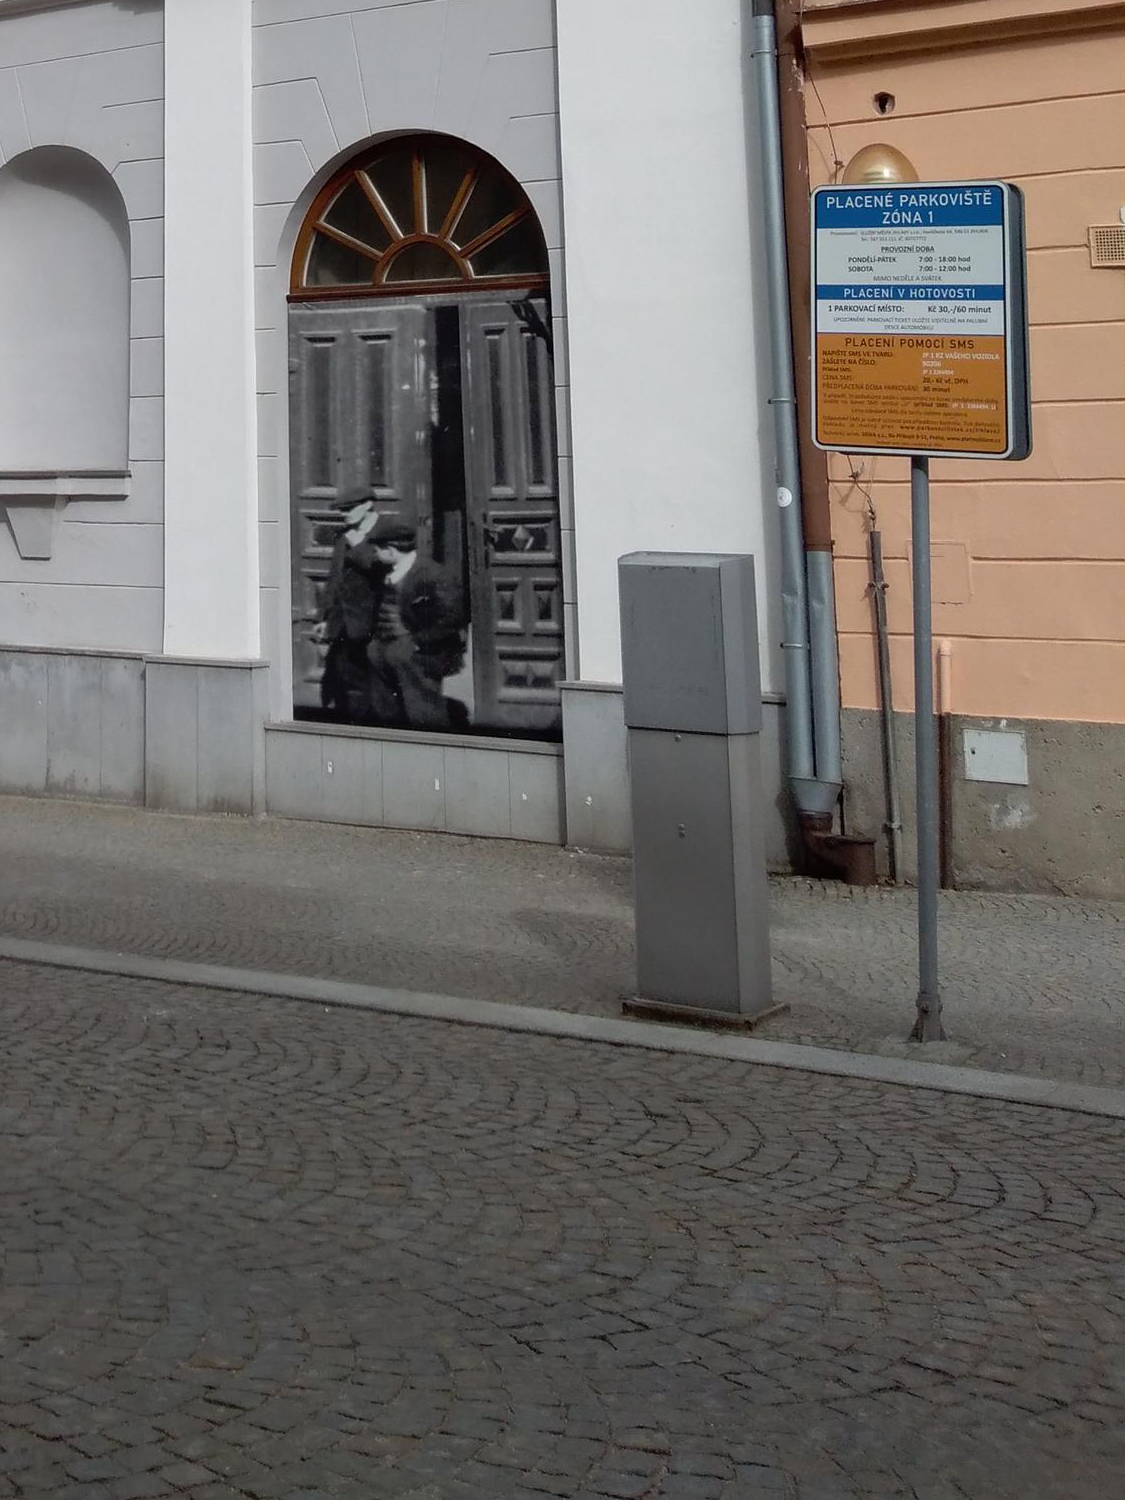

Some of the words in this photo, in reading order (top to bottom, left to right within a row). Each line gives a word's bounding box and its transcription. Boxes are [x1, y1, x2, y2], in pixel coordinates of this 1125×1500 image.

[826, 192, 893, 209] PLACENÉ
[899, 189, 992, 208] PARKOVIŠTĚ
[882, 209, 923, 225] ZÓNA
[928, 210, 934, 224] 1
[881, 244, 914, 253] PROVOZNÍ
[915, 245, 935, 253] DOBA
[847, 255, 897, 263] PONDĚLÍ-PÁTEK
[847, 265, 874, 273] SOBOTA
[843, 286, 893, 298] PLACENÍ
[897, 288, 905, 298] V
[909, 288, 975, 299] HOTOVOSTI
[834, 304, 875, 312] PARKOVACÍ
[877, 303, 905, 312] MÍSTO:
[927, 305, 936, 313] Kč
[938, 305, 967, 314] 30,-/60
[845, 336, 894, 348] PLACENÍ
[900, 337, 944, 349] POMOCÍ
[949, 339, 975, 349] SMS
